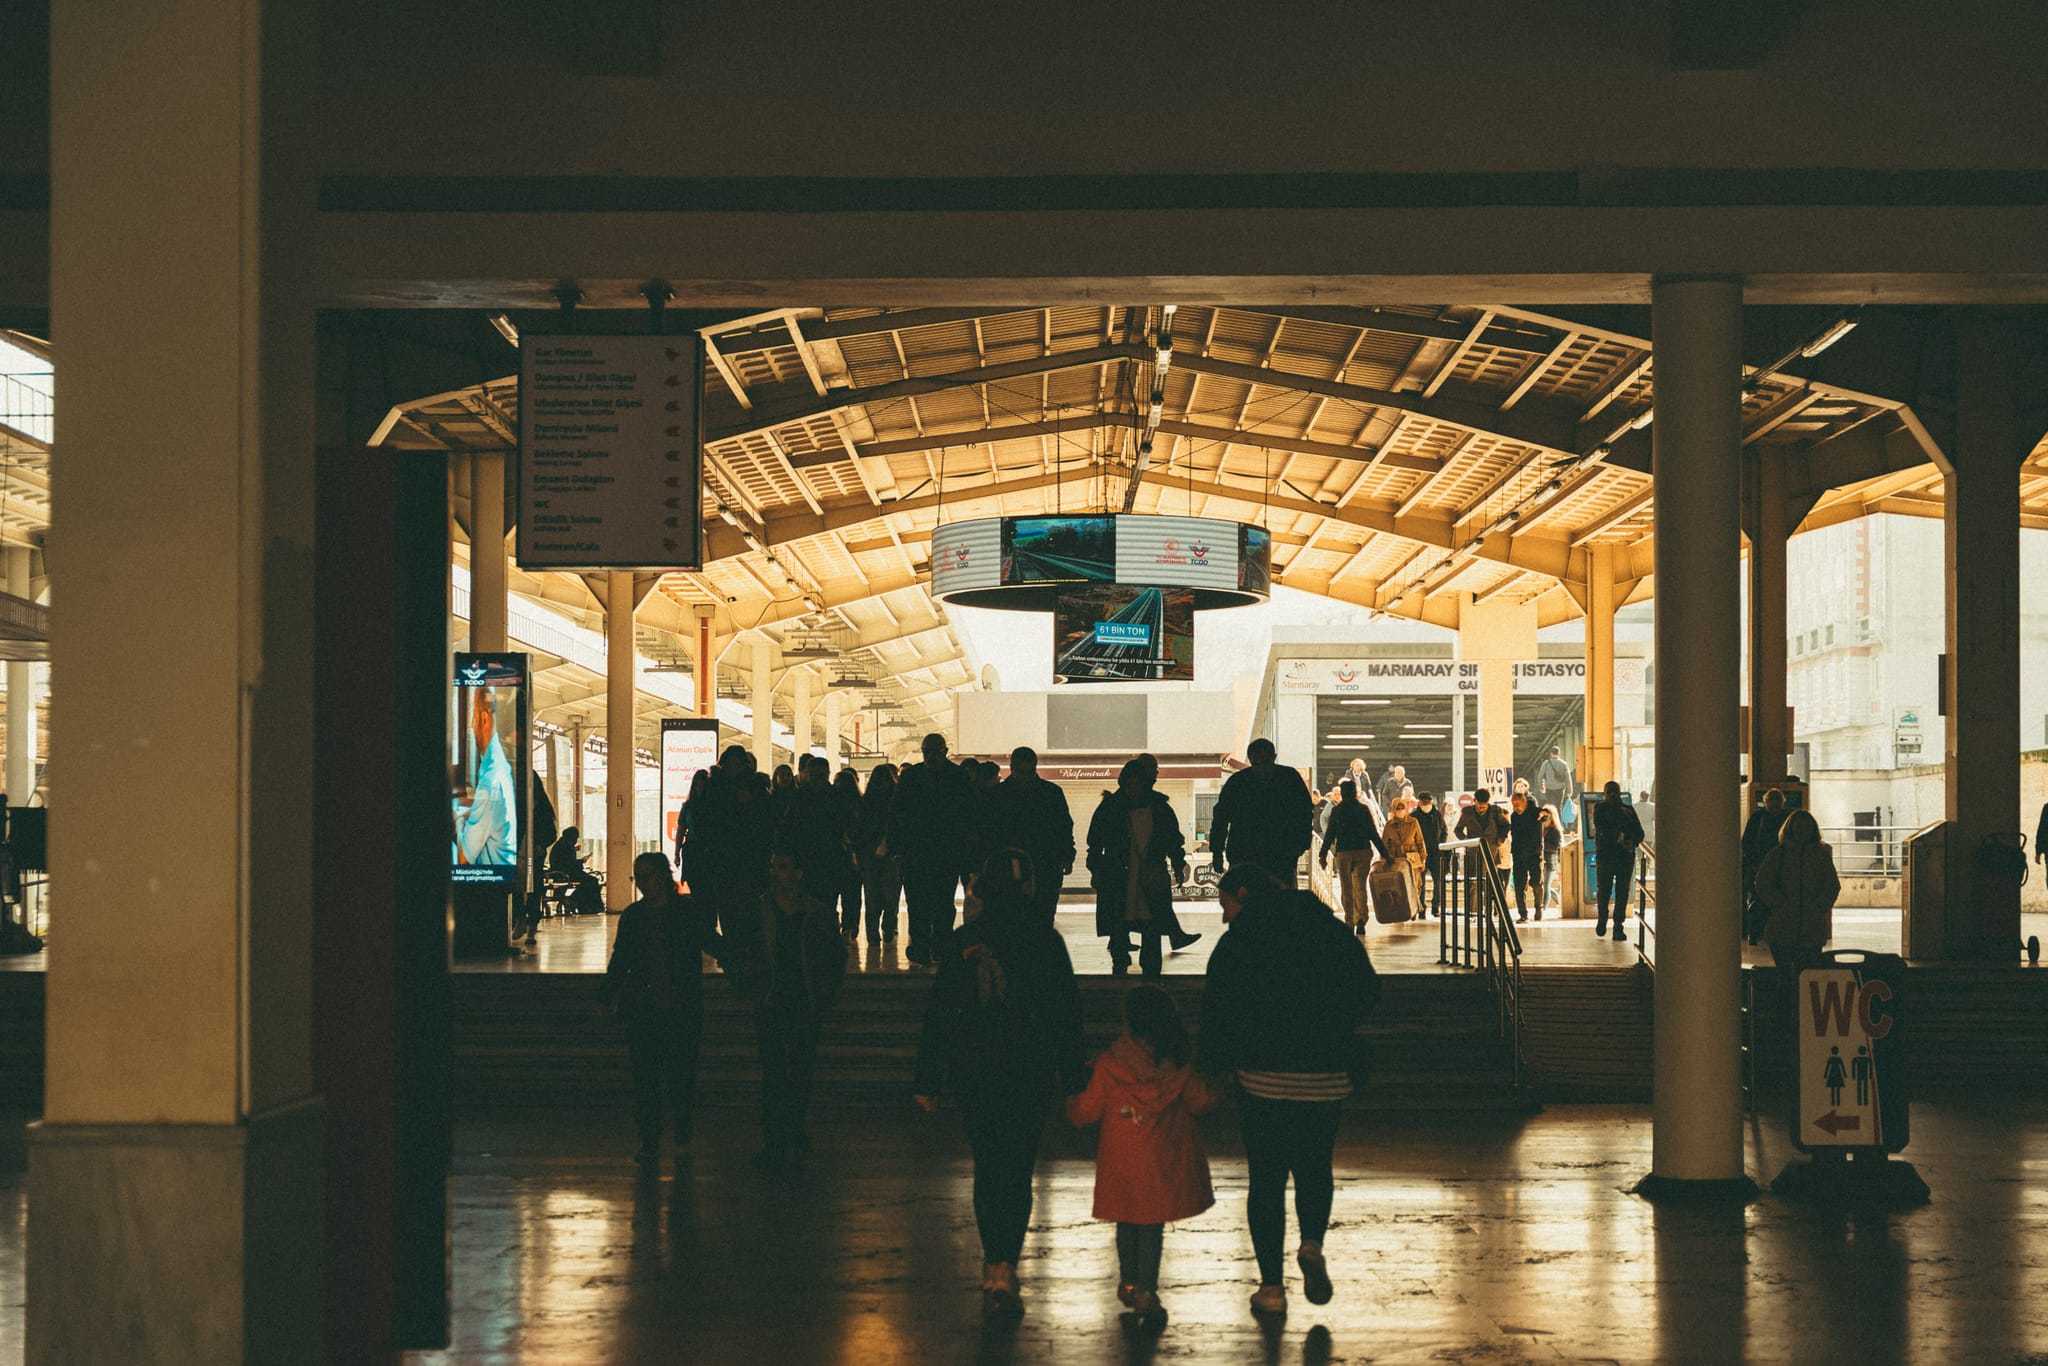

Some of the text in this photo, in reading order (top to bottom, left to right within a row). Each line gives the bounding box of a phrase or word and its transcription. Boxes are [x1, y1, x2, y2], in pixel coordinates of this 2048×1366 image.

[1099, 625, 1109, 634] 61
[1127, 626, 1145, 636] TON
[1368, 664, 1454, 677] MARMARAY
[1523, 664, 1585, 677] ISTASYO
[1282, 681, 1320, 692] Marmaray
[1485, 769, 1503, 784] WC
[1809, 978, 1894, 1039] WC
